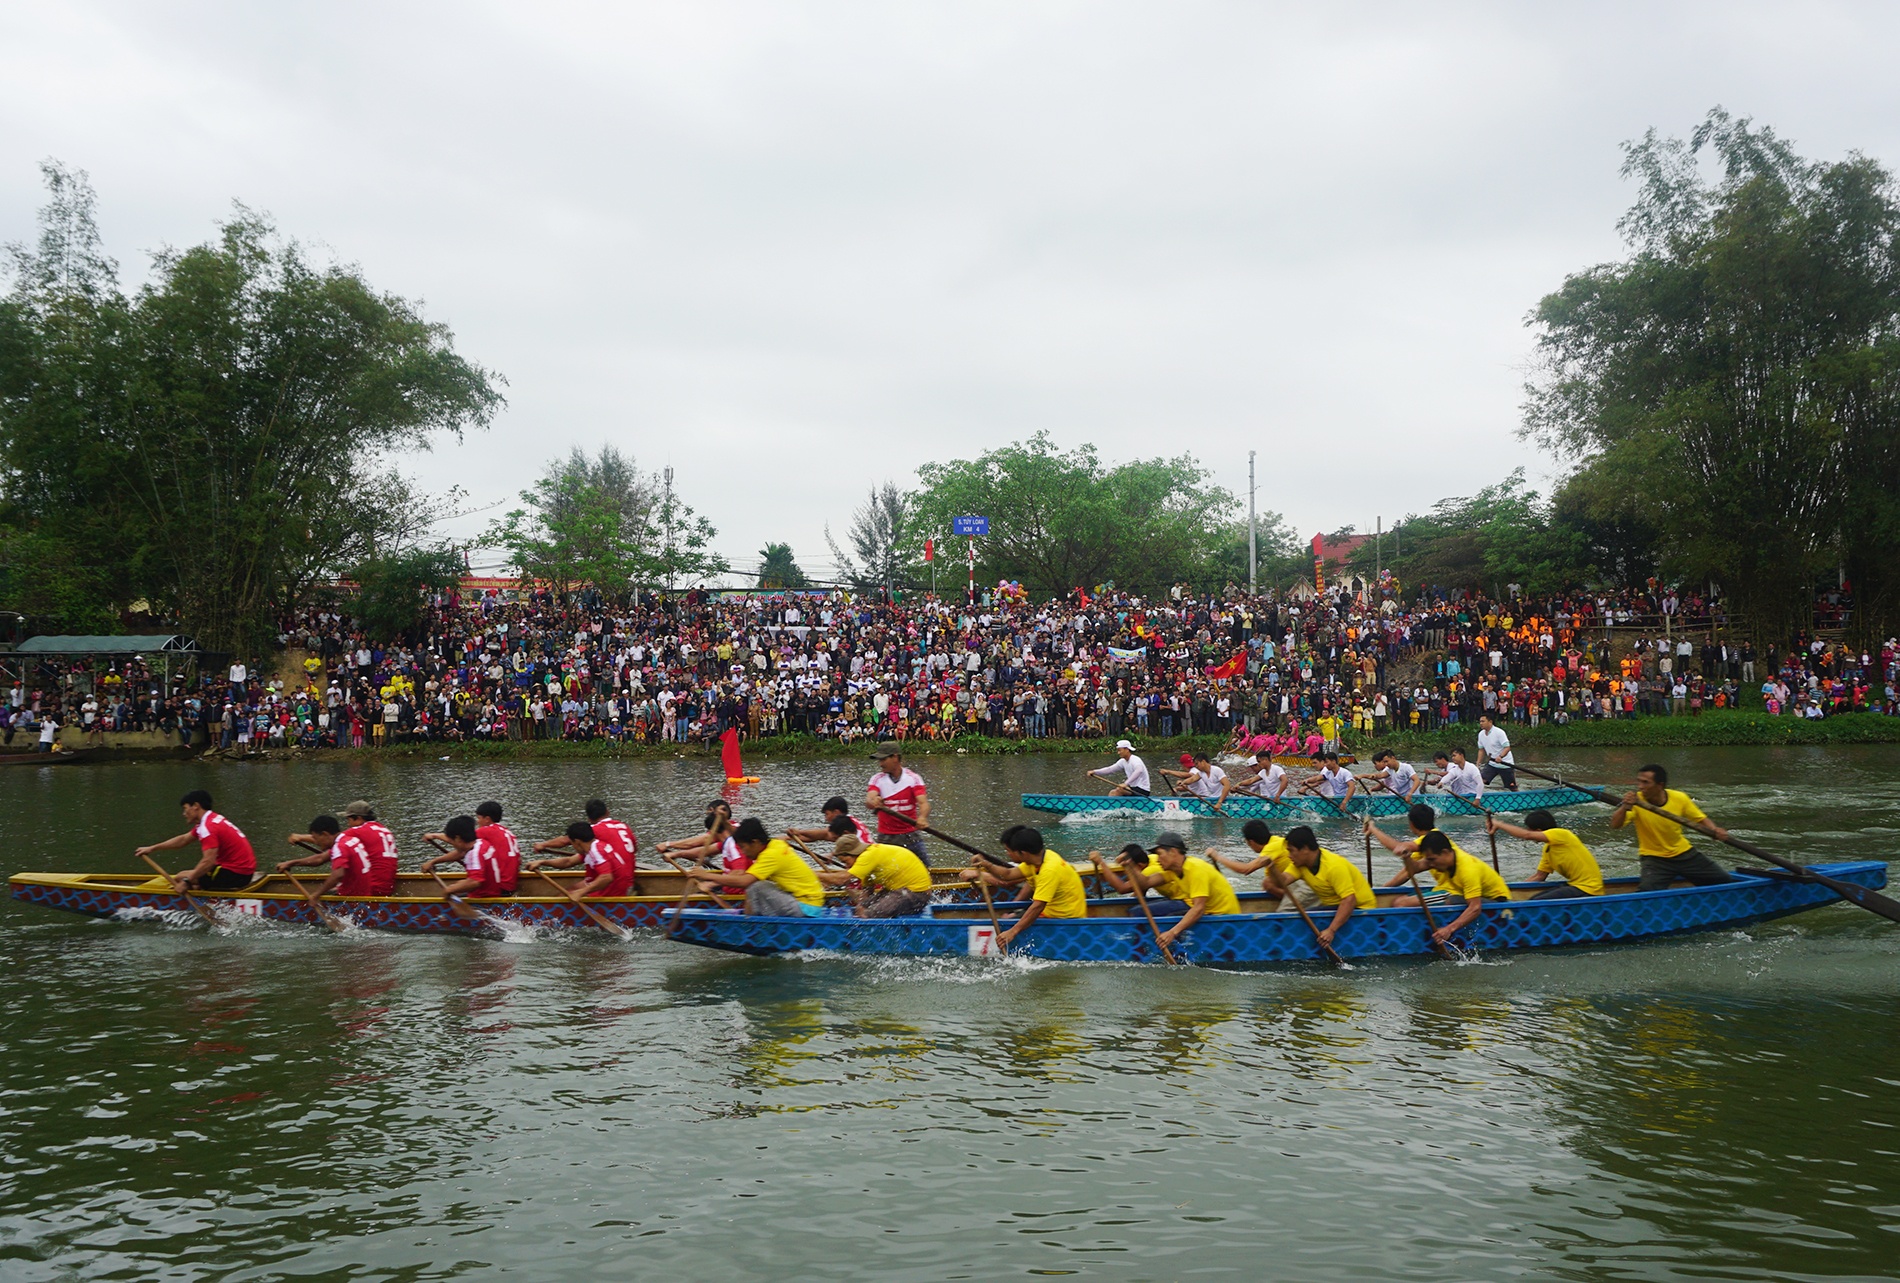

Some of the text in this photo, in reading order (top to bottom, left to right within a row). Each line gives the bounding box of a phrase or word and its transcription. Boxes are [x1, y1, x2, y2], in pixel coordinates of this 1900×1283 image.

[378, 832, 398, 858] 12
[617, 829, 635, 853] 5
[975, 930, 993, 956] 7
